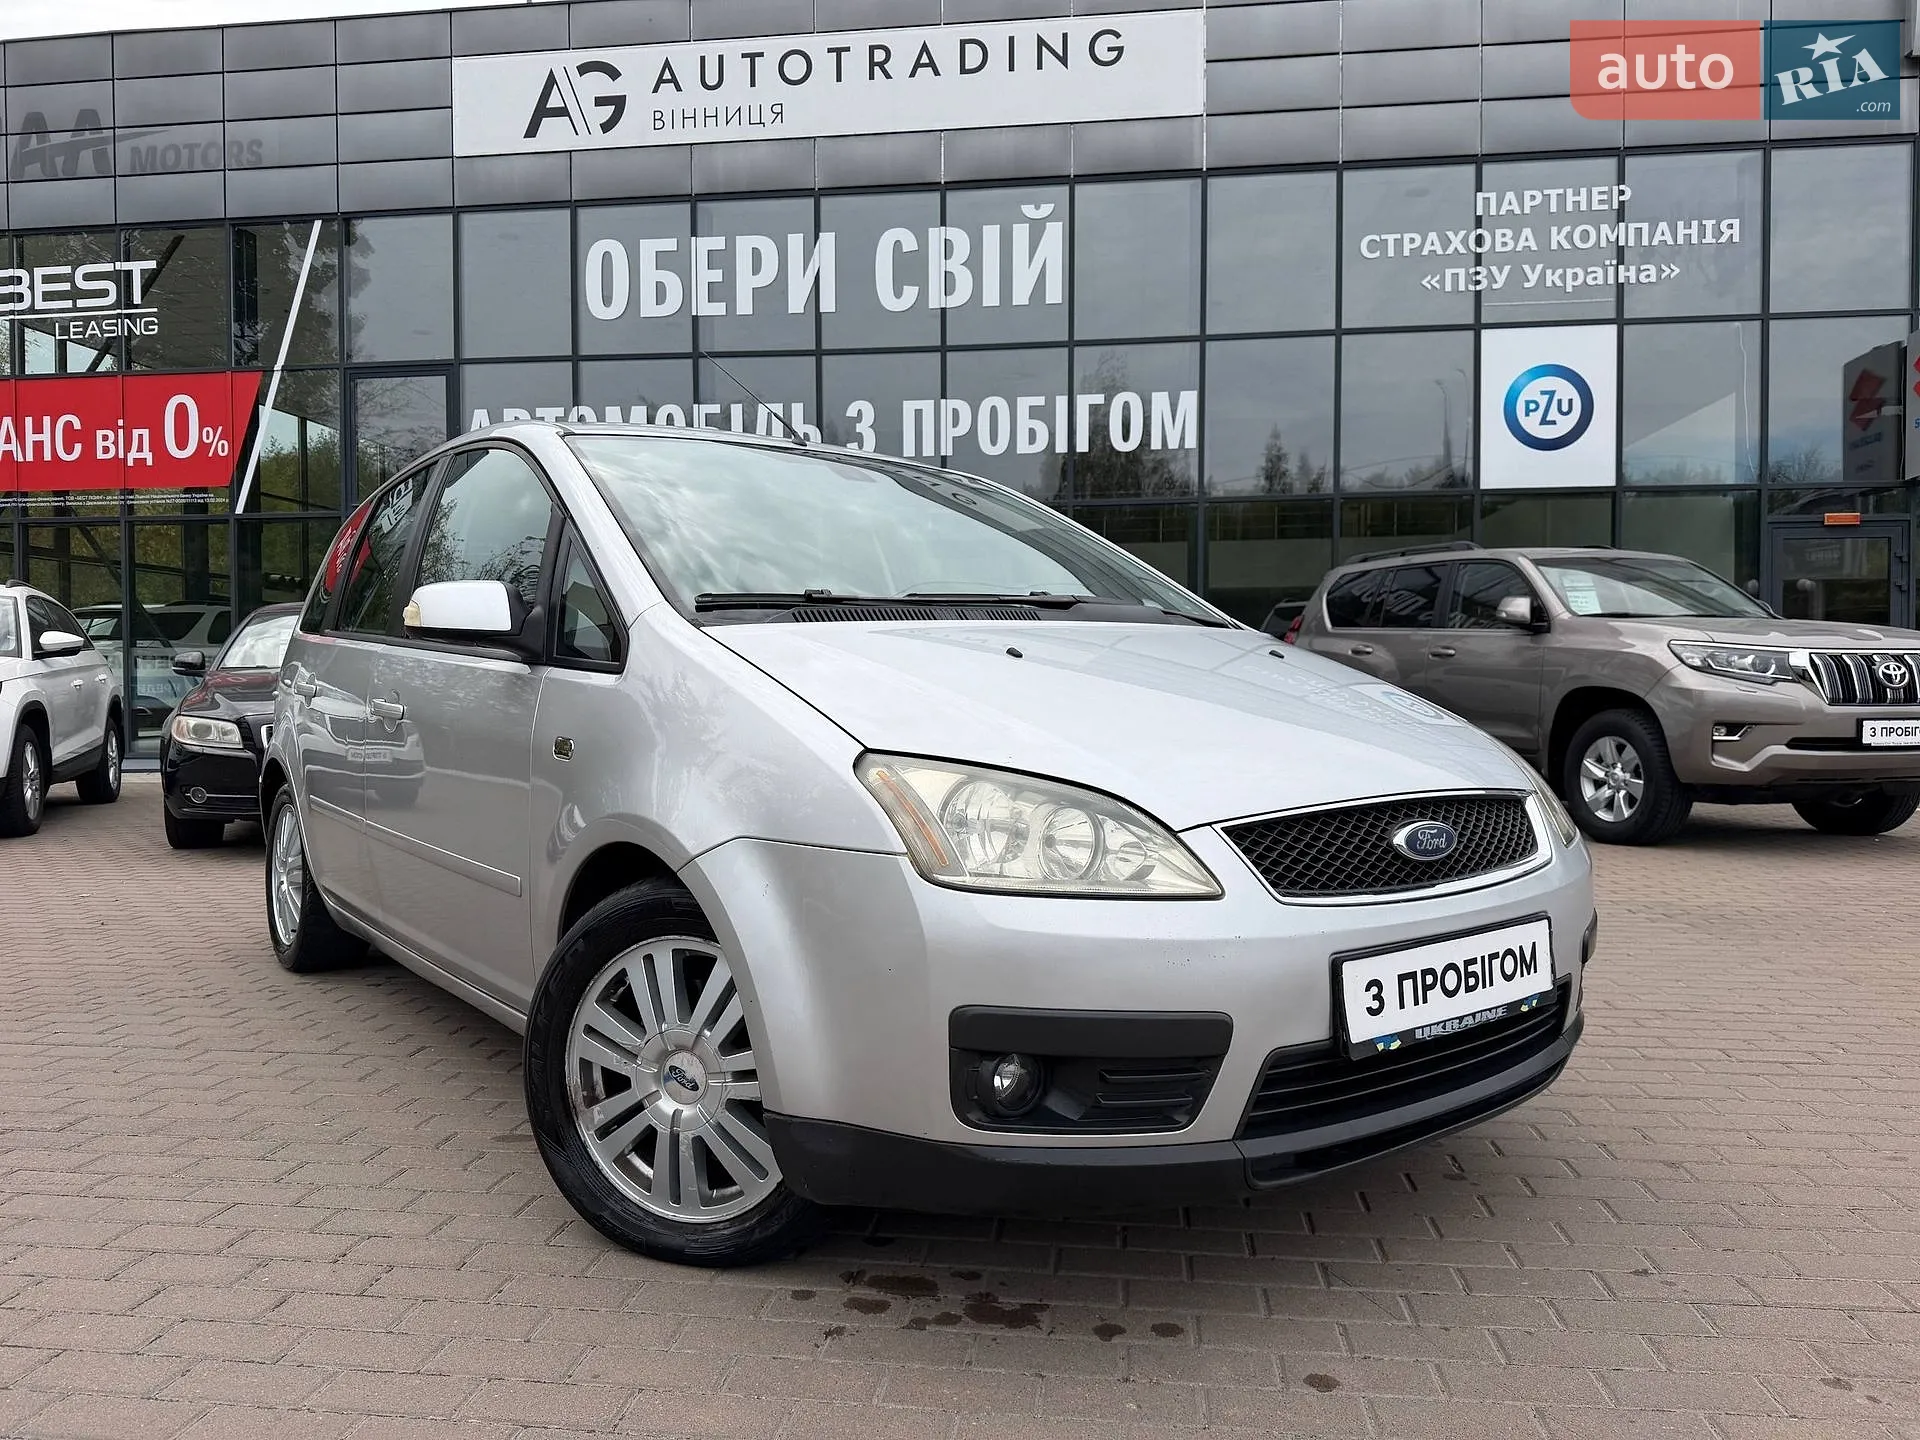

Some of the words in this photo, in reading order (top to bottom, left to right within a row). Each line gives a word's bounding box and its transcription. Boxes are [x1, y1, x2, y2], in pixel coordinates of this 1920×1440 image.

[651, 28, 1125, 94] AUTOTRADING
[652, 103, 784, 132] ВІННИЦЯ
[129, 139, 263, 173] MOTORS
[1475, 184, 1632, 216] ПАРТНЕР
[1359, 226, 1538, 259] СТРАХОВА
[1550, 218, 1741, 251] КОМПАНІЯ
[585, 231, 836, 320] ОБЕРИ
[875, 203, 1063, 312] СВІЙ
[1420, 265, 1512, 293] «ПЗУ
[1521, 261, 1681, 293] Україна»
[0, 260, 157, 312] BEST
[55, 317, 158, 340] LEASING
[903, 390, 1198, 458] ПРОБІГОМ
[1524, 390, 1573, 425] PZU
[96, 419, 153, 466] від
[164, 394, 229, 459] 0%
[1880, 726, 1920, 737] ПРОБІГ
[1416, 828, 1448, 851] Ford
[1397, 941, 1538, 1010] ПРОБІГОМ
[1415, 1005, 1508, 1040] UKRAINE
[671, 1068, 697, 1090] Ford
